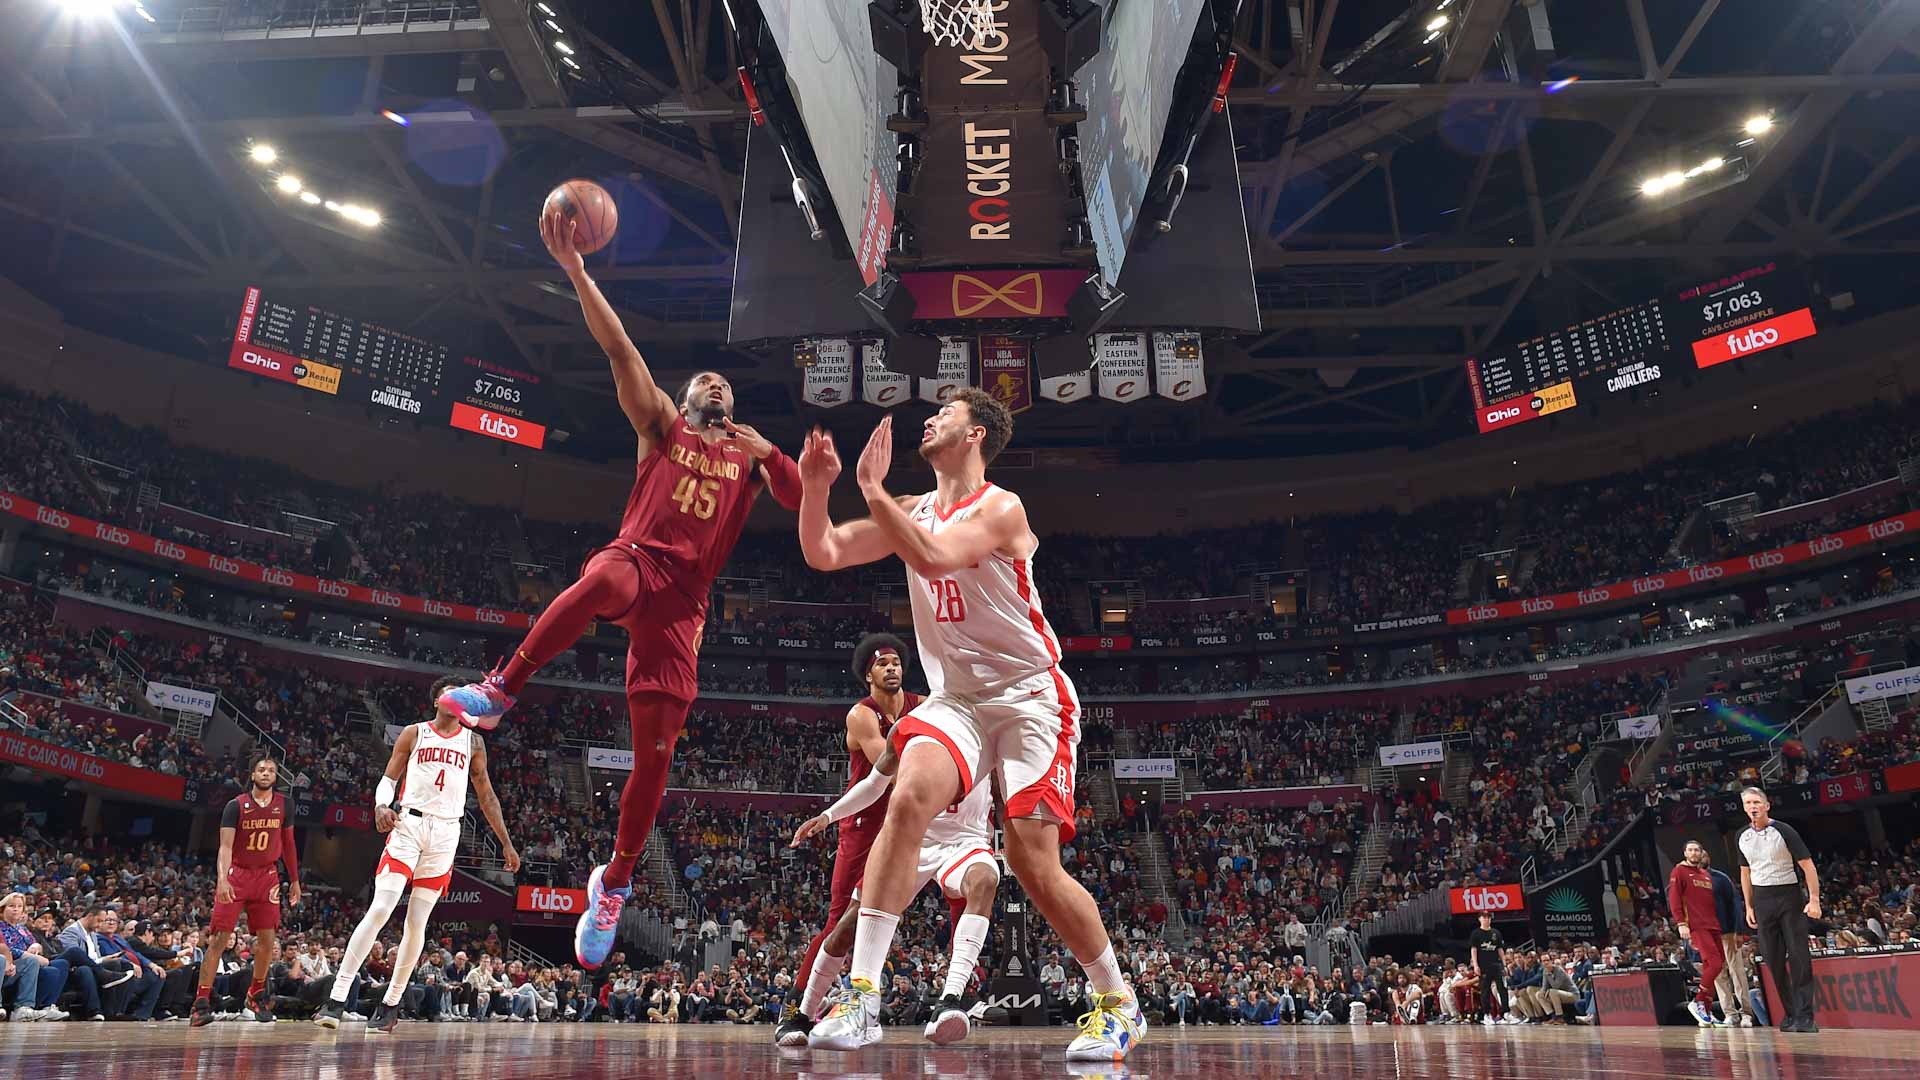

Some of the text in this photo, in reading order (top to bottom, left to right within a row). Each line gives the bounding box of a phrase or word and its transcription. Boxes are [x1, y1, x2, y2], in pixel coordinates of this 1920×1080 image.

[965, 123, 1010, 240] ROCKET
[1702, 290, 1762, 322] $7,063
[267, 326, 284, 335] Green
[1726, 326, 1778, 355] fubo
[243, 351, 280, 371] Ohio
[817, 356, 845, 365] ASTERN
[997, 350, 1012, 359] NBA
[1105, 350, 1138, 358] EASTERN
[806, 365, 851, 374] CONFERENCE
[983, 358, 1026, 368] CHAMPIONS
[1100, 359, 1145, 368] CONFERENCE
[1617, 361, 1645, 376] CLEVELAND
[308, 371, 337, 385] Rental
[808, 375, 849, 384] CHAMPIONS
[866, 374, 907, 383] CHAMPIONS
[938, 371, 965, 380] MPIONS
[1102, 369, 1144, 377] CHAMPIONS
[1492, 369, 1511, 379] Mitchell
[1607, 365, 1661, 392] CAVALIERS
[386, 385, 412, 398] CLEVELAND
[474, 378, 521, 403] $7,063
[1545, 391, 1572, 404] Rental
[371, 389, 421, 414] CAVALIERS
[1487, 407, 1520, 424] Ohio
[479, 412, 518, 439] fubo
[670, 444, 740, 481] CLEVELAND
[672, 474, 721, 520] 45
[36, 506, 70, 529] fubo
[95, 523, 130, 545] fubo
[1867, 519, 1905, 541] fubo
[154, 539, 186, 561] fubo
[1808, 536, 1844, 557] fubo
[208, 554, 239, 575] fubo
[1748, 551, 1784, 571] fubo
[261, 567, 294, 587] fubo
[1688, 565, 1723, 583] fubo
[317, 579, 349, 598] fubo
[1632, 576, 1665, 595] fubo
[371, 590, 401, 608] fubo
[929, 579, 965, 623] 28
[1577, 588, 1610, 605] fubo
[423, 600, 453, 617] fubo
[1466, 606, 1498, 622] fubo
[1521, 598, 1554, 614] fubo
[475, 608, 505, 624] fubo
[1353, 614, 1443, 633] LET EM KNOW.
[732, 636, 750, 645] TOL
[778, 638, 808, 648] FOULS
[1100, 638, 1114, 649] 59
[1141, 638, 1163, 648] FG%
[1196, 634, 1228, 646] FOULS
[1257, 632, 1277, 642] TOL
[834, 641, 855, 650] FG%
[1727, 654, 1768, 669] RCKET
[1875, 674, 1920, 691] CLIFFS
[172, 694, 211, 709] CLIFFS
[1721, 692, 1761, 706] RCKET
[1721, 733, 1752, 745] Homes
[5, 737, 104, 778] THE CAVS ON fubo
[417, 747, 466, 770] ROCKETS
[610, 755, 633, 764] CLIF
[1403, 747, 1441, 758] CLIFFS
[1137, 764, 1173, 772] CLIFFS
[434, 769, 445, 791] 4
[1874, 781, 1881, 791] 0
[184, 790, 197, 801] 59
[1827, 783, 1844, 798] 59
[336, 809, 344, 822] 0
[1694, 803, 1711, 817] 72
[242, 818, 280, 830] CLEVELAND
[246, 831, 269, 851] 10
[530, 887, 573, 911] fubo
[1463, 888, 1509, 911] fubo
[1545, 913, 1592, 922] CASAMIGOS
[1813, 965, 1912, 1018] ATGEEK
